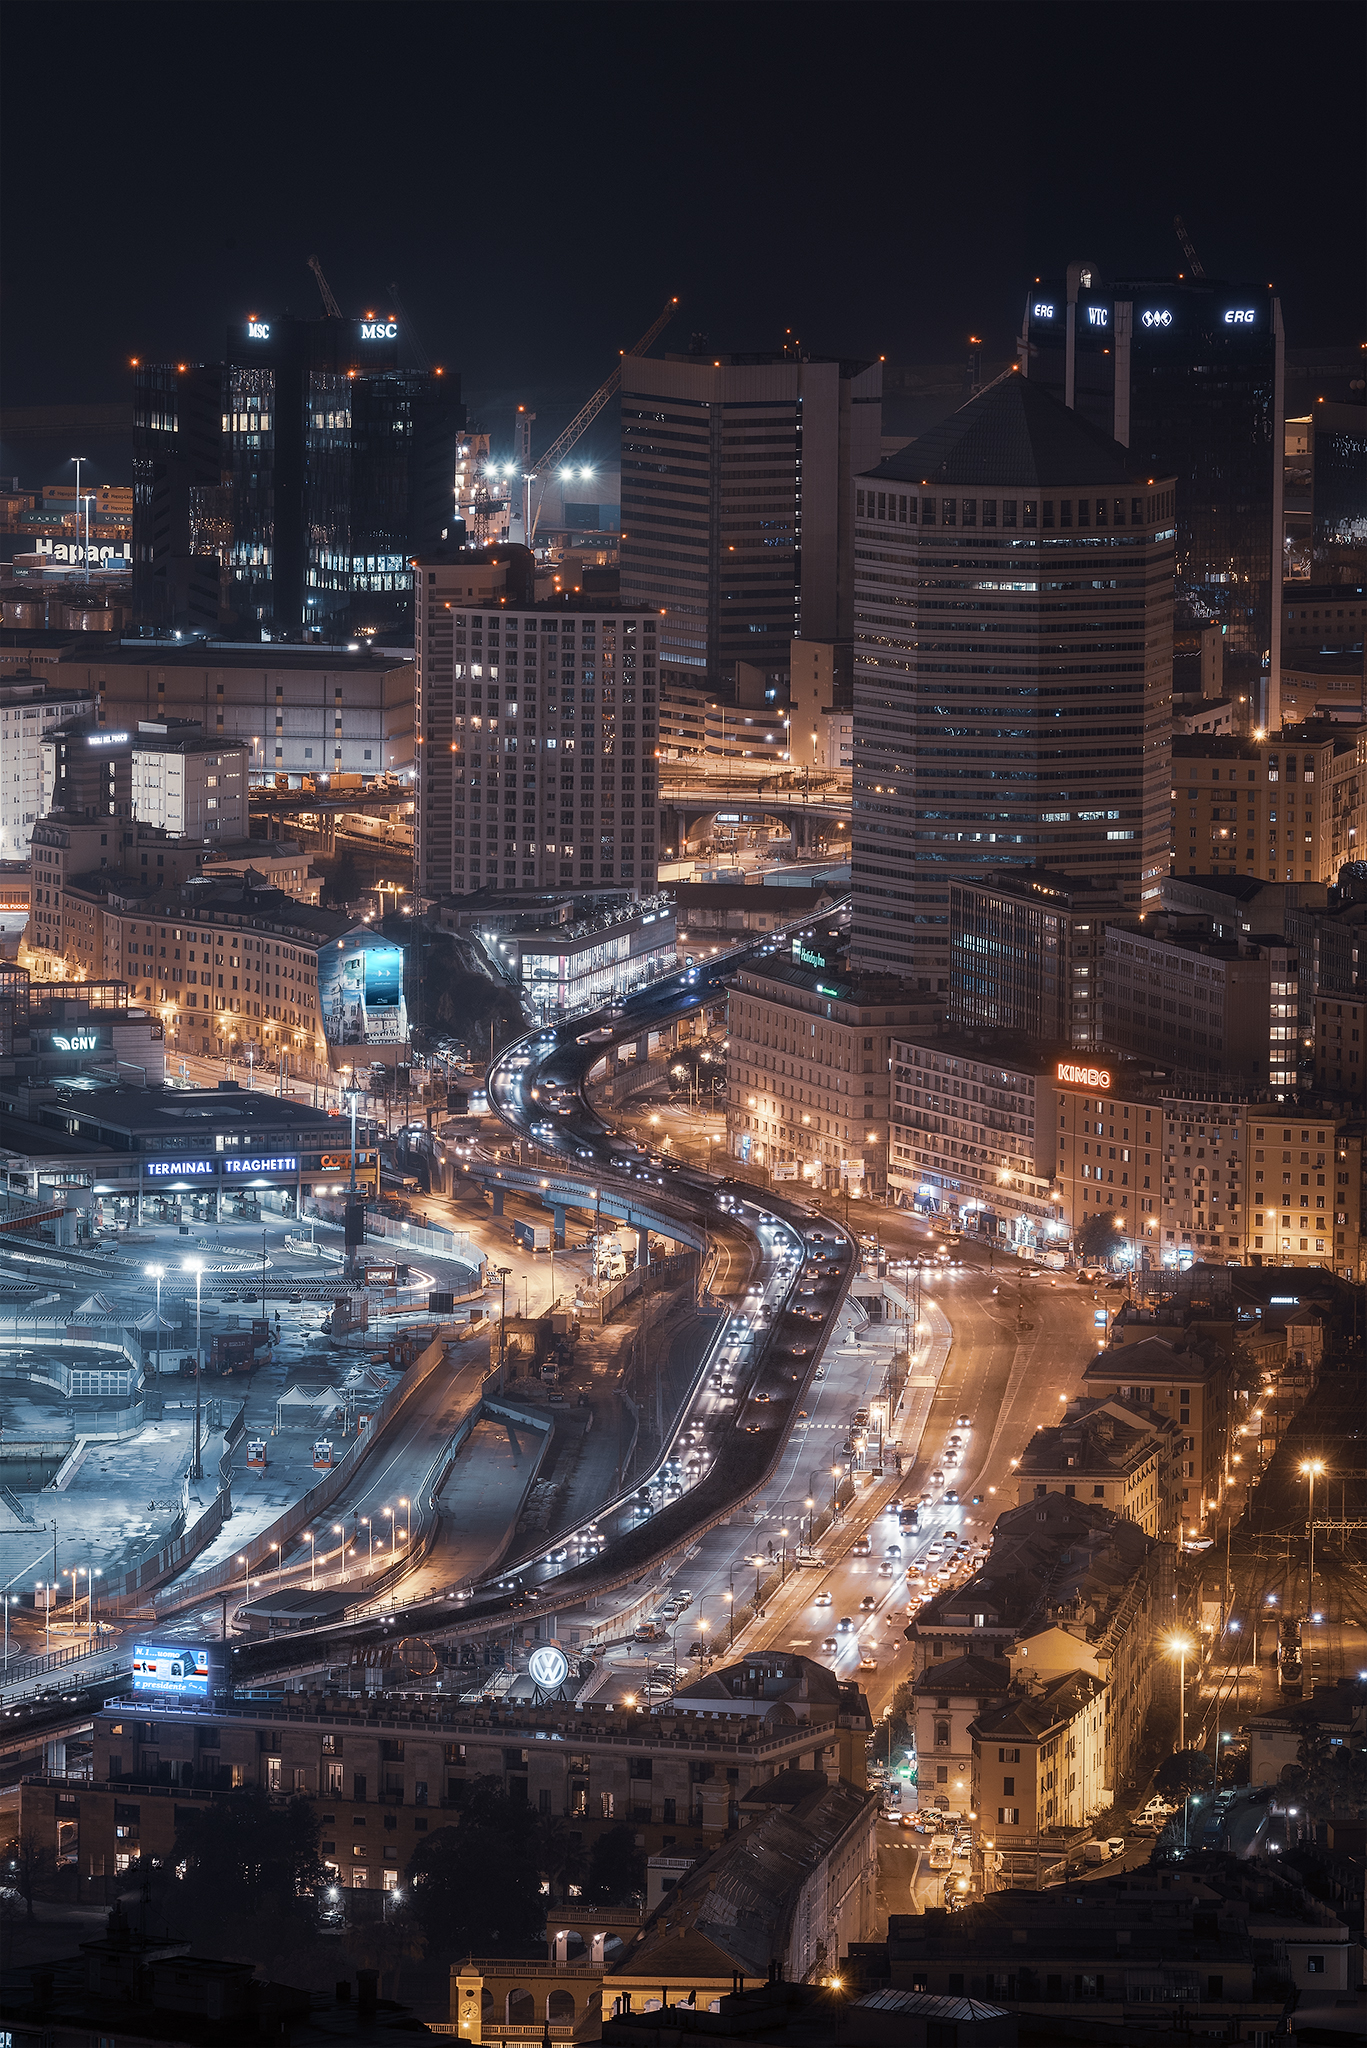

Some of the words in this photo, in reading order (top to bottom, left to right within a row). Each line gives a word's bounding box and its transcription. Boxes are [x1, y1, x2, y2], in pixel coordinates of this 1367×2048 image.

[1034, 304, 1054, 318] ERG
[1088, 307, 1108, 326] WTC
[1224, 310, 1255, 323] ERG
[248, 322, 270, 339] MSC
[361, 323, 398, 339] MSC
[71, 1036, 97, 1050] GNV
[1058, 1063, 1111, 1089] KIMBO
[148, 1161, 213, 1175] TERMINAL
[225, 1158, 296, 1172] TRAGHETTI
[141, 1681, 187, 1691] presidente
